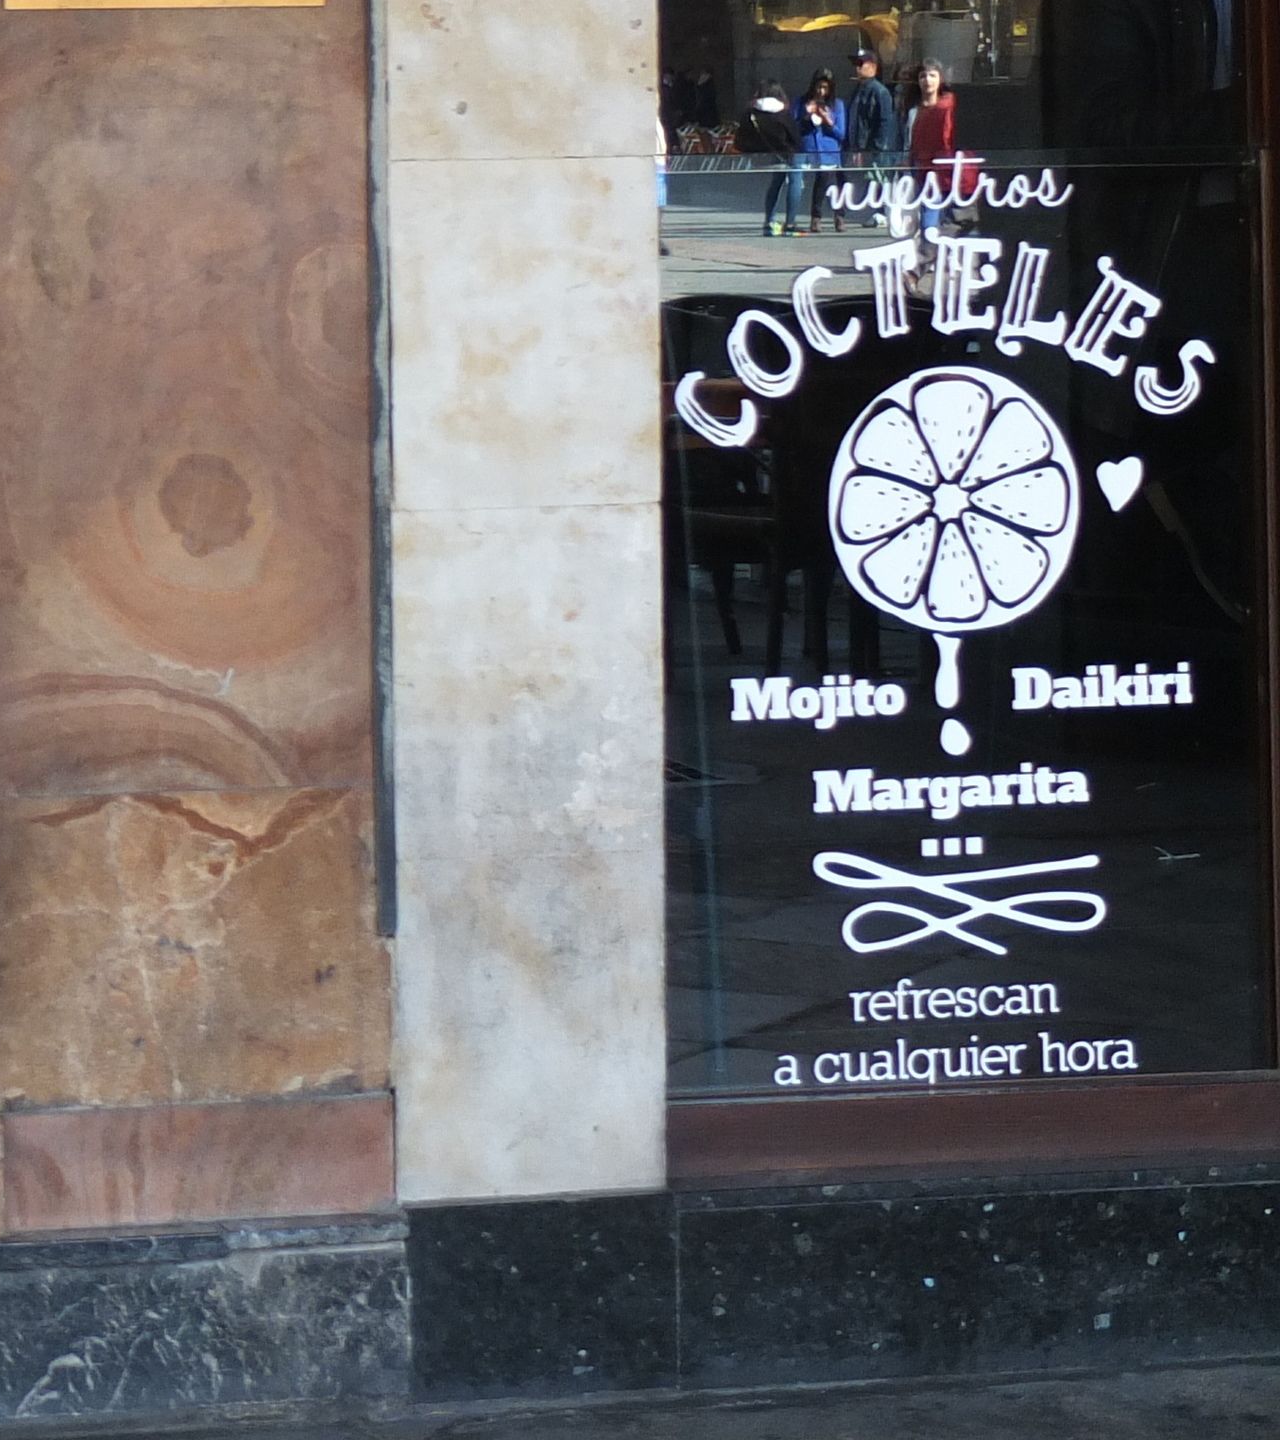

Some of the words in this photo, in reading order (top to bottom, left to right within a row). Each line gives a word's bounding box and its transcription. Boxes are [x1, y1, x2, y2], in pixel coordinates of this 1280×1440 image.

[825, 151, 1075, 211] nuestros
[674, 227, 1217, 448] COCTELES
[730, 674, 906, 729] Mojito
[1010, 662, 1194, 711] Daikiri
[812, 762, 1091, 819] Margarita
[849, 977, 1061, 1023] refrescan
[773, 1053, 801, 1086] a
[813, 1035, 1029, 1086] cualquier
[1038, 1032, 1139, 1074] hora
